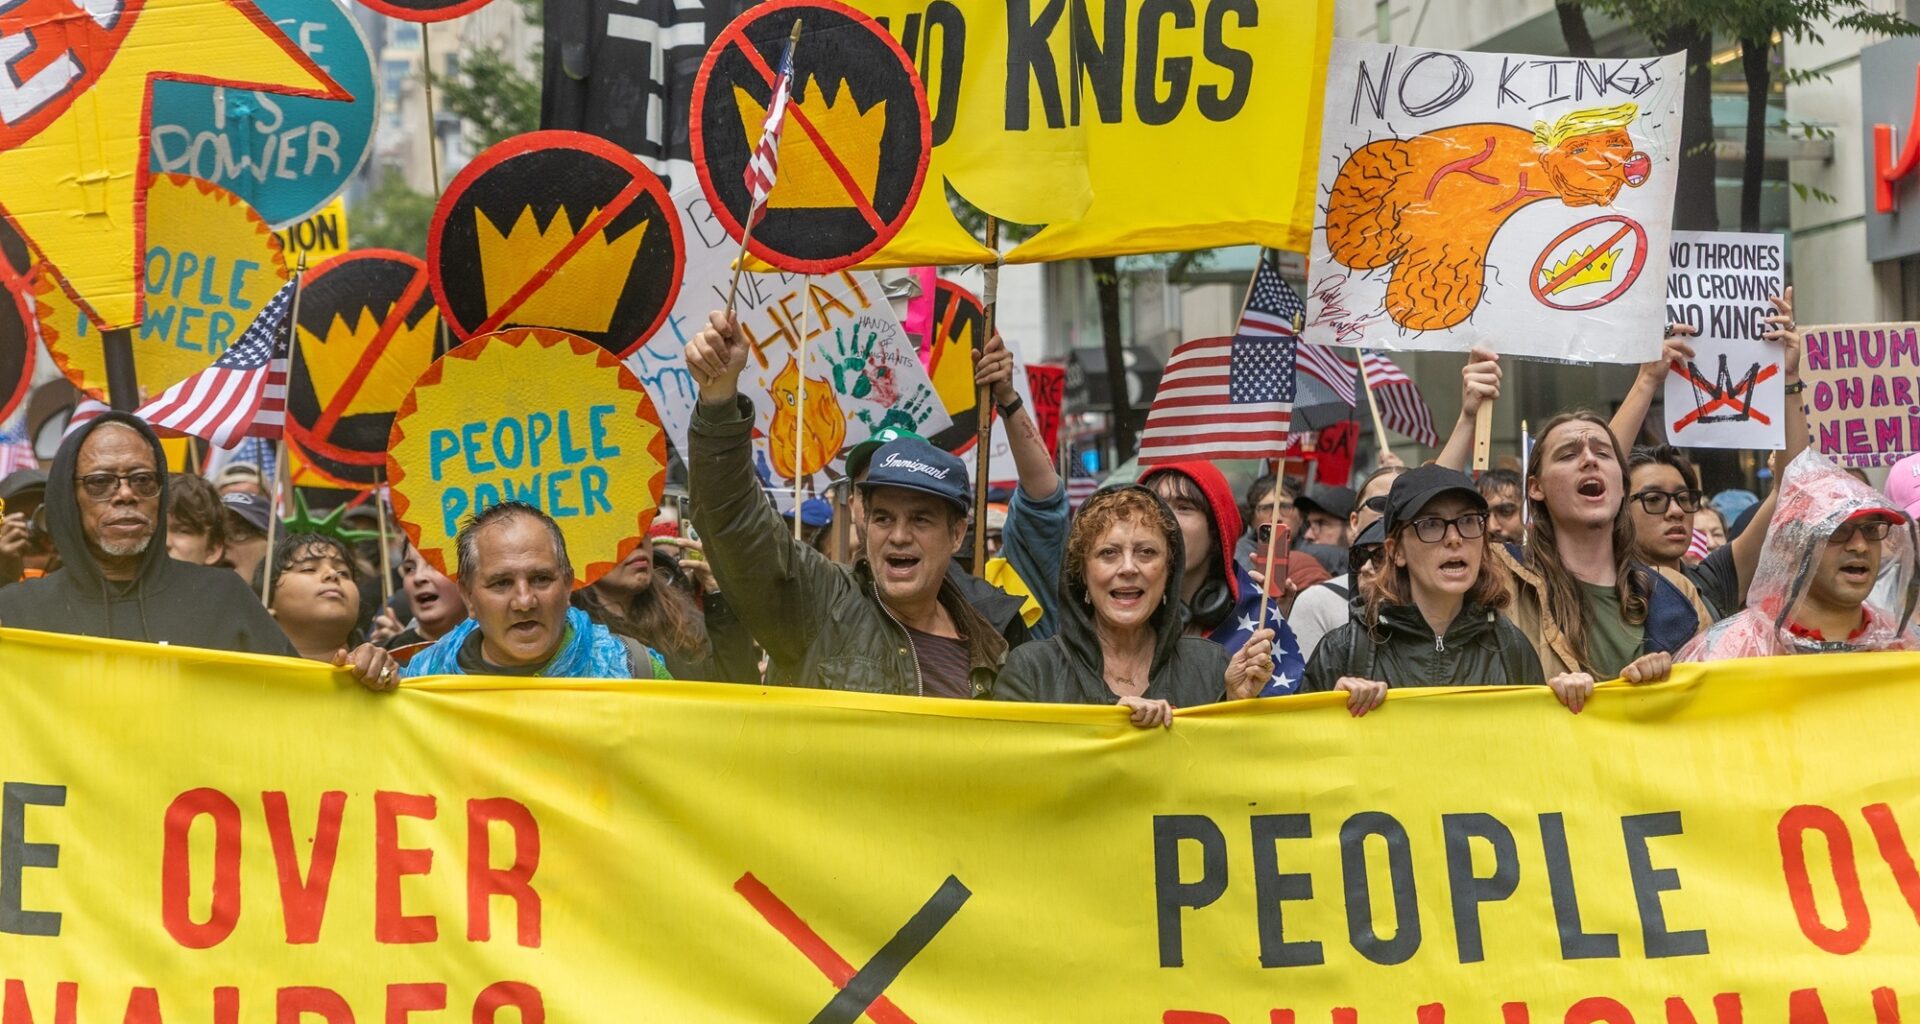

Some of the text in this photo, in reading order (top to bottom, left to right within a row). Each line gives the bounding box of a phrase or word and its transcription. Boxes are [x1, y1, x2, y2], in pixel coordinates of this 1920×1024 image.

[1350, 45, 1663, 126] NO KINGS
[151, 120, 341, 184] POWER
[1669, 242, 1780, 271] NO THRONES
[1666, 273, 1780, 301] NO CROWNS
[858, 315, 897, 338] HANDS
[1666, 304, 1704, 337] NO
[429, 404, 621, 482] PEOPLE
[879, 452, 950, 480] Immigrant
[1842, 454, 1882, 468] THE
[440, 465, 613, 538] POWER
[162, 787, 541, 949] OVER
[1153, 811, 1710, 968] PEOPLE
